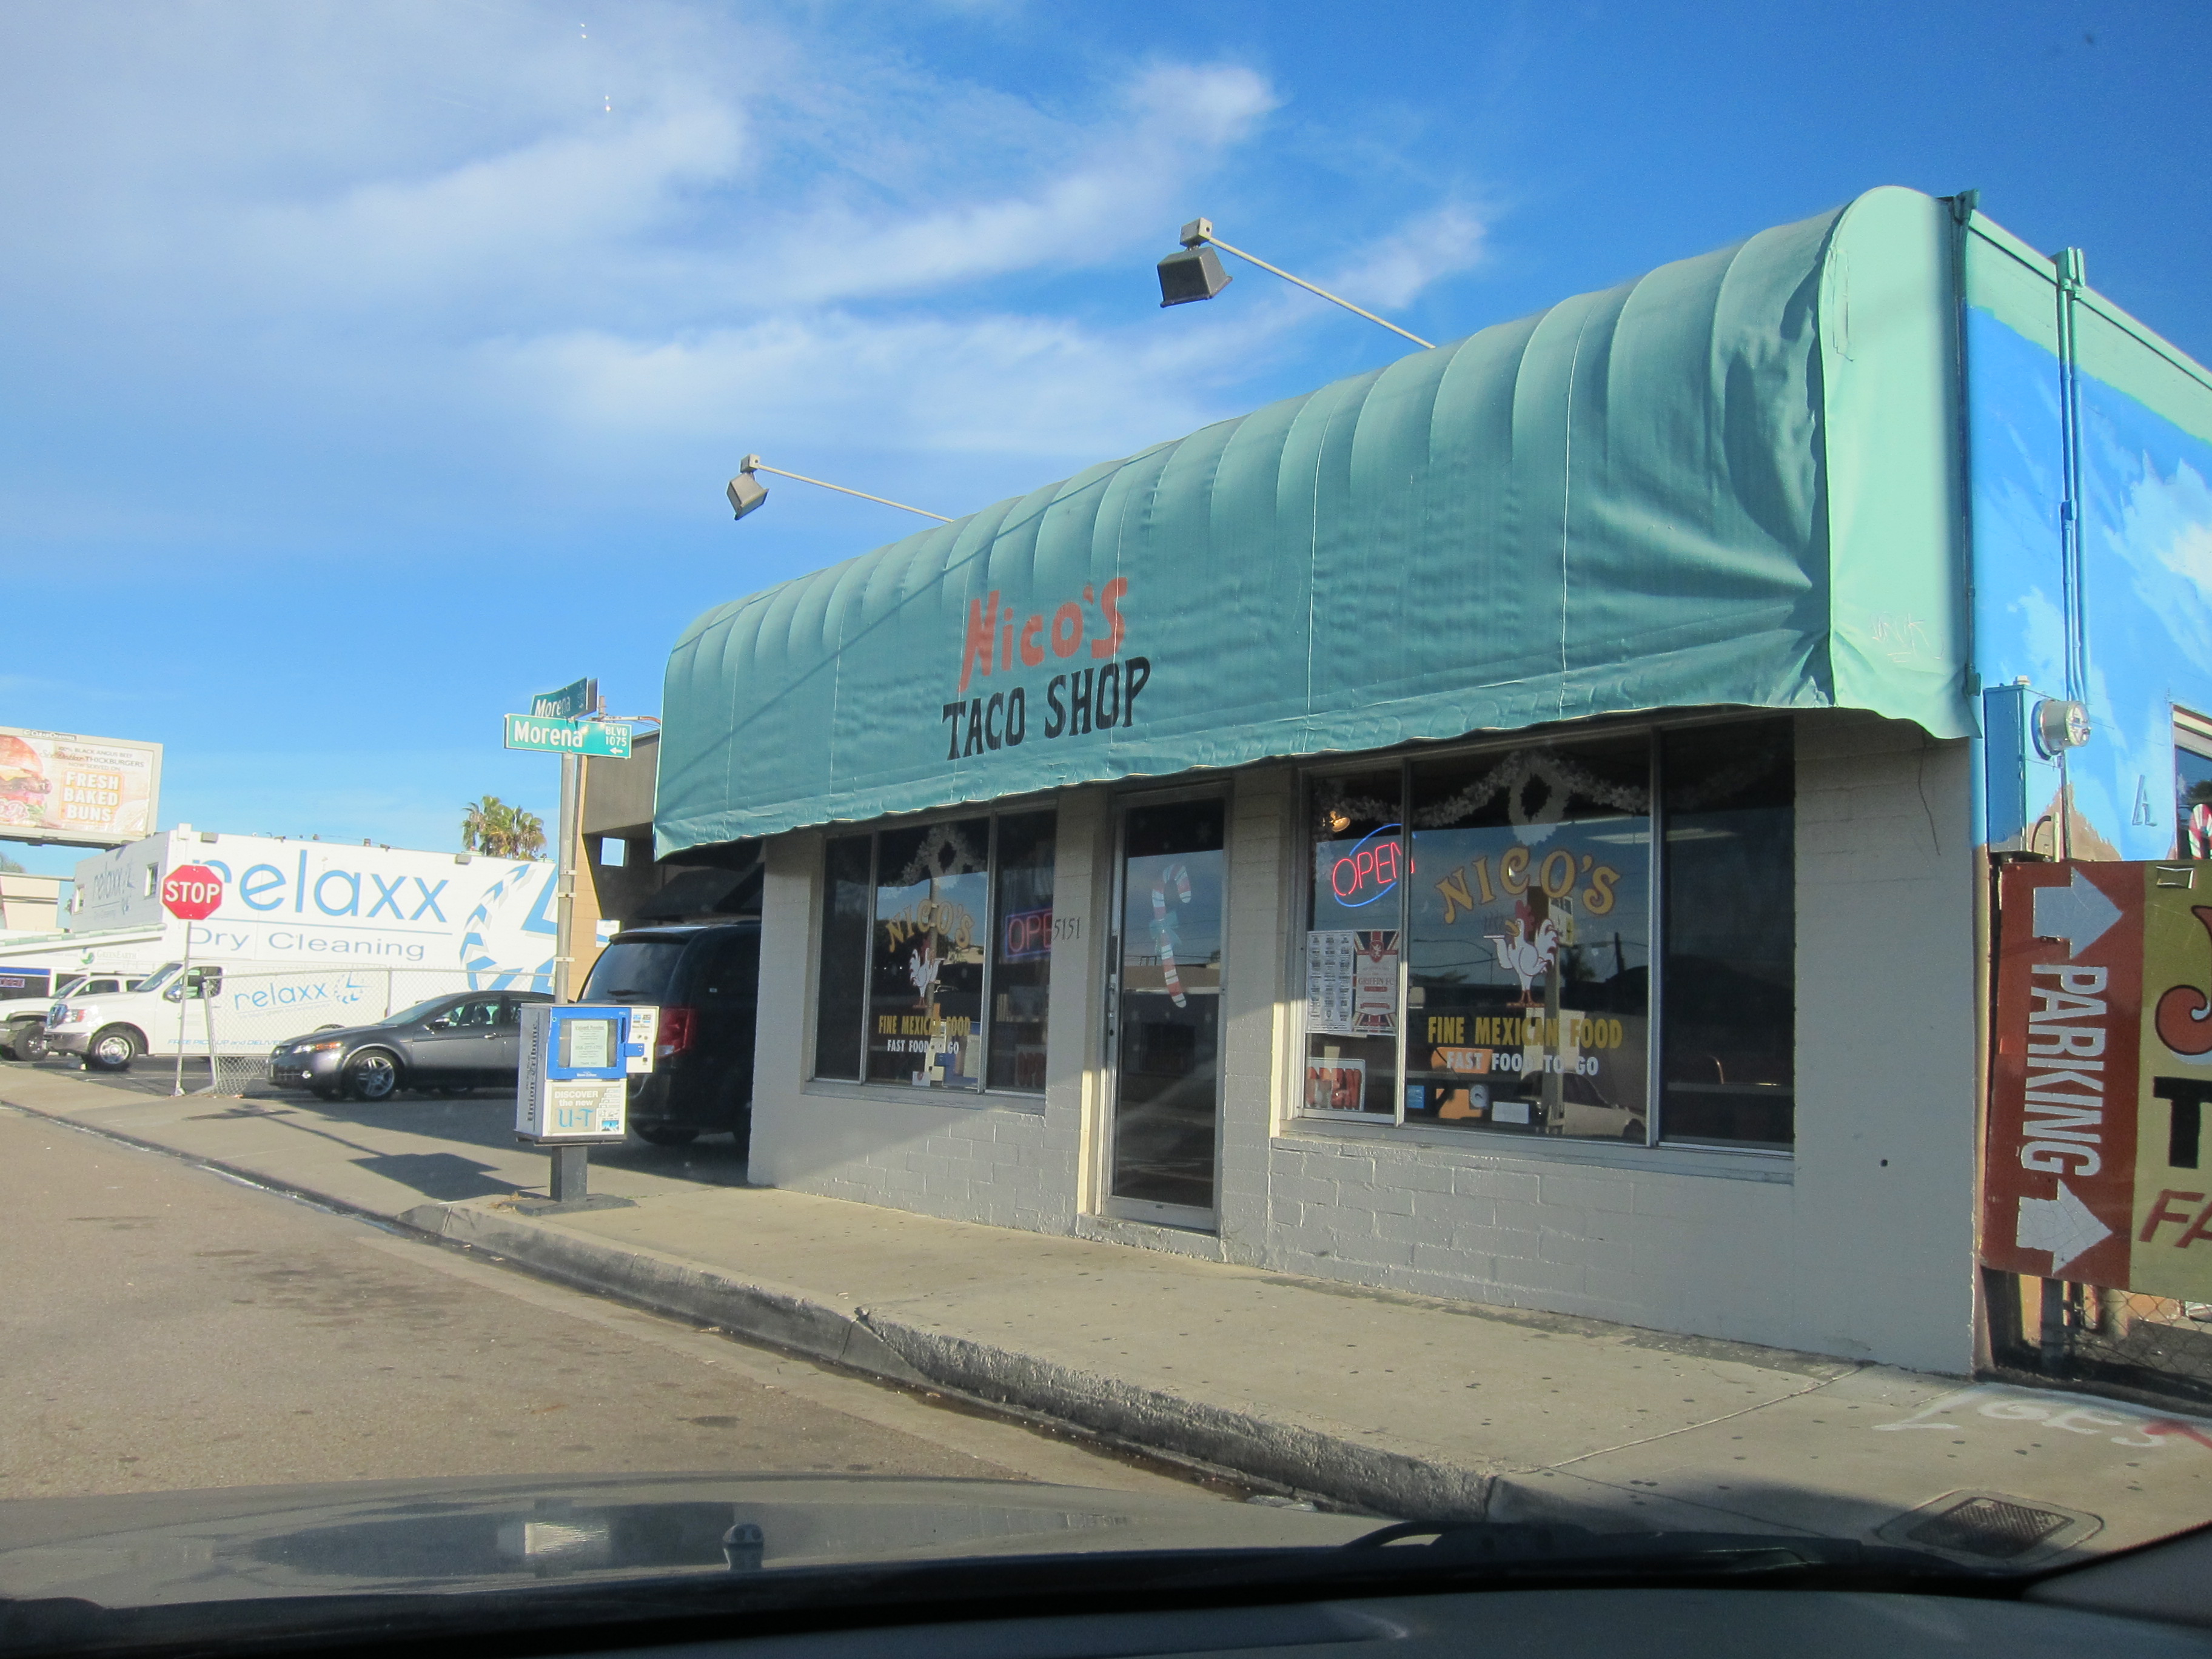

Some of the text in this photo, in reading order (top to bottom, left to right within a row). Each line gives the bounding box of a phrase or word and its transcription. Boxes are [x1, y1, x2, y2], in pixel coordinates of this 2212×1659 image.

[535, 697, 571, 717] Morena
[942, 656, 1150, 760] TACO SHOP
[514, 720, 628, 747] Morena BLVD
[605, 737, 628, 746] 1075
[85, 756, 145, 768] THICKBURGERS
[65, 771, 119, 791] FRESH
[64, 787, 118, 806] BAKED
[67, 804, 112, 822] BUNS
[1332, 842, 1415, 896] OPEN
[164, 880, 220, 905] STOP
[1435, 846, 1621, 924] NICO'S
[885, 899, 975, 953] NICO'S
[1008, 912, 1053, 953] OPE
[1054, 916, 1081, 940] 5151
[189, 927, 425, 960] Dry Cleaning
[234, 983, 329, 1011] relaxx
[879, 1015, 897, 1034] FINE
[946, 1016, 970, 1036] FOOD
[1428, 1016, 1623, 1049] FINE MEXICAN FOOD
[887, 1039, 905, 1052] FAST
[908, 1039, 929, 1053] FOOD
[947, 1041, 959, 1054] GO
[1446, 1051, 1600, 1076] FAST FOOD TO GO
[2020, 964, 2108, 1176] PARKING
[554, 1090, 598, 1099] DISCOVER
[557, 1107, 595, 1128] U-T
